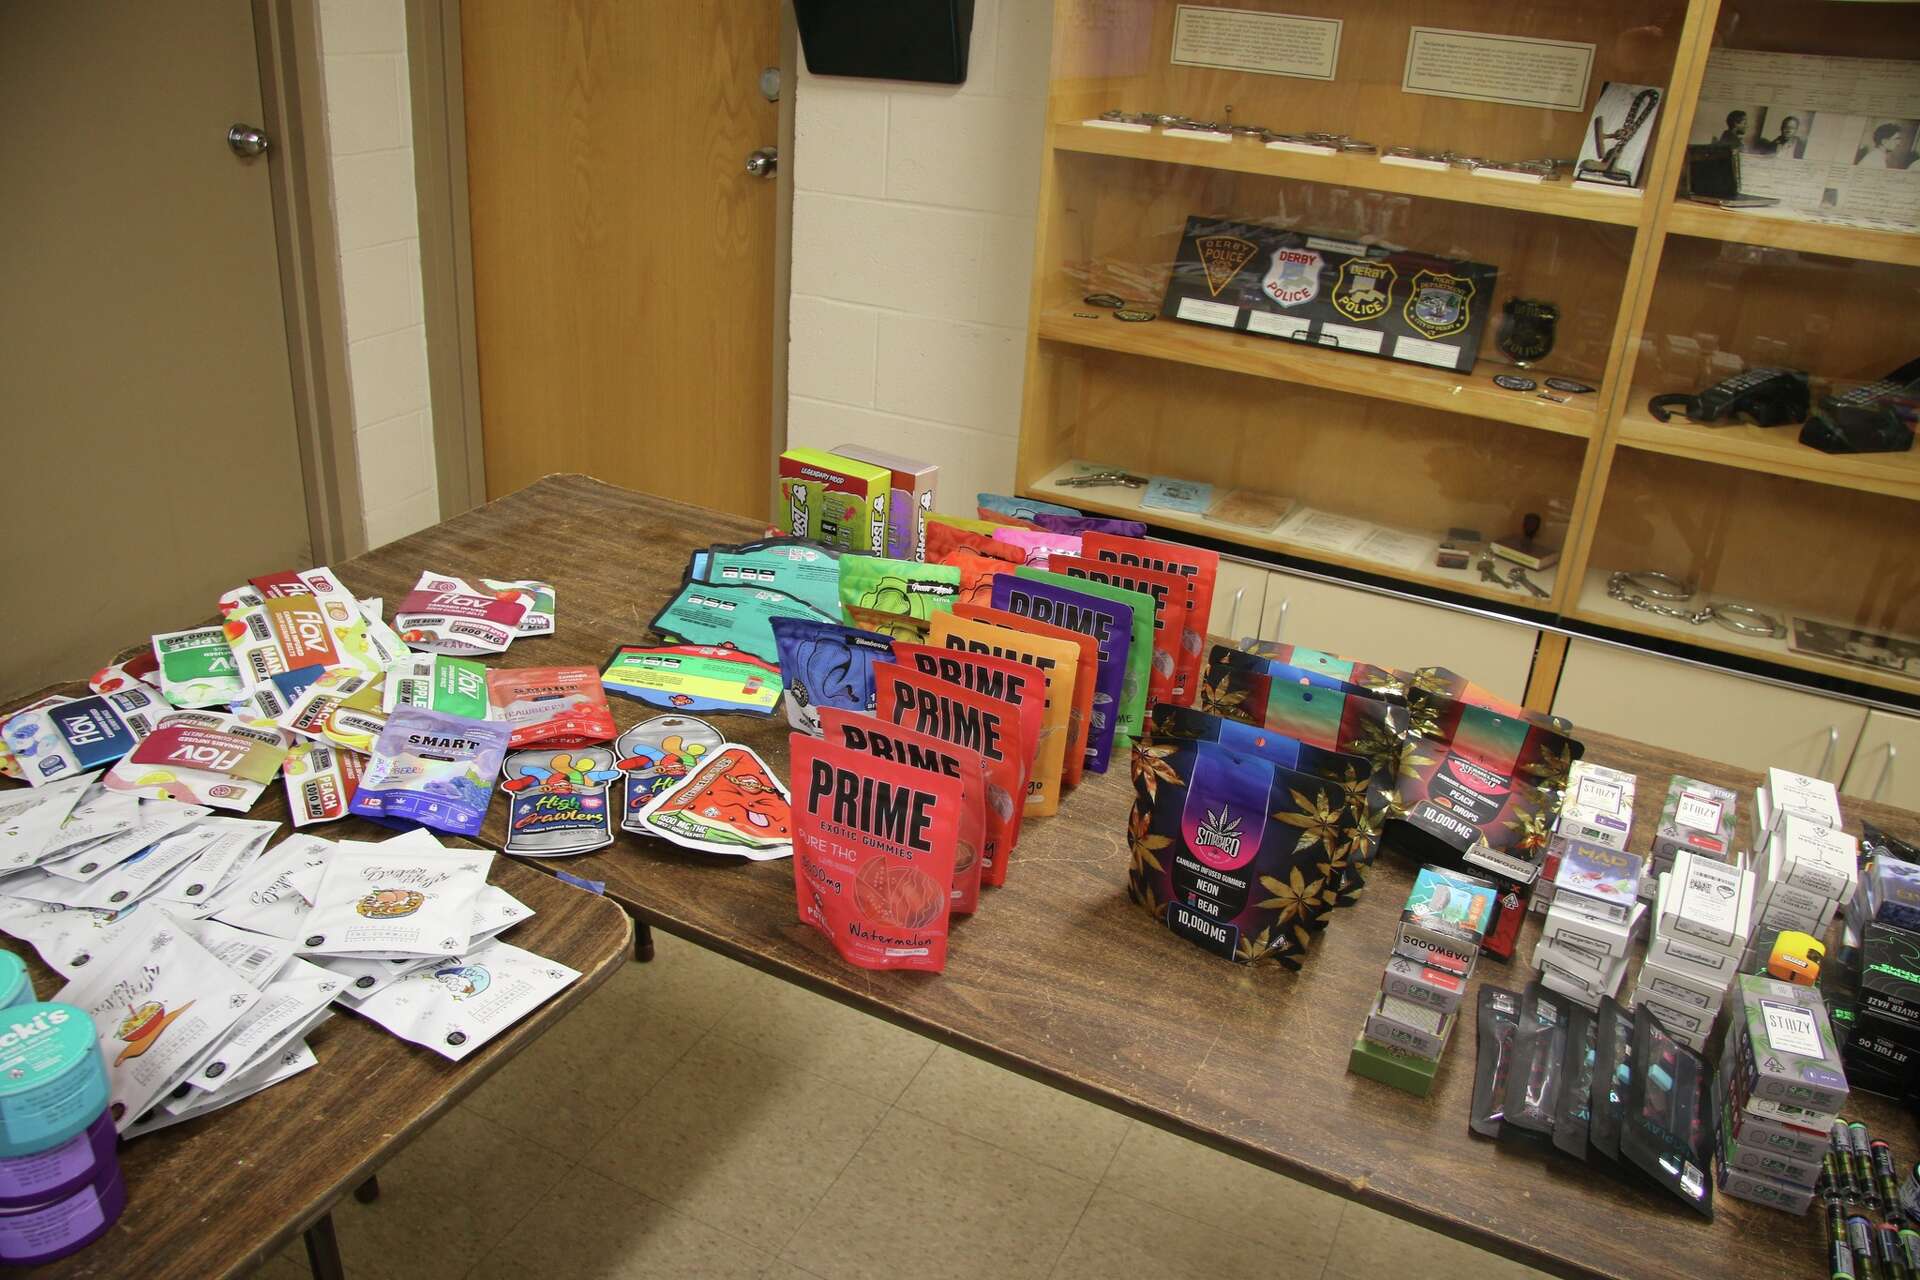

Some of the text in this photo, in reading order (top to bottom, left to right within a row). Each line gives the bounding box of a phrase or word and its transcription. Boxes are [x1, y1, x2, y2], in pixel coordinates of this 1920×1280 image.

[1206, 241, 1250, 252] DERBY
[1206, 248, 1244, 262] POLICE
[1280, 251, 1317, 266] DERBY
[1350, 265, 1388, 280] DERBY
[1267, 282, 1311, 301] POLICE
[1339, 296, 1383, 314] POLICE
[871, 512, 886, 558] HOST
[432, 593, 494, 608] flav
[293, 611, 329, 653] flav
[455, 625, 500, 643] 1000 MG
[855, 637, 889, 650] Blueberry
[252, 653, 267, 676] 1000
[261, 647, 282, 675] MAN
[299, 714, 311, 728] MG
[315, 697, 342, 726] PEACH
[892, 679, 1003, 763] PRIME
[66, 715, 104, 746] flav
[178, 736, 250, 753] CANNABIS INFUSED
[408, 735, 480, 750] SMART
[168, 745, 245, 770] flav
[320, 776, 337, 809] PEACH
[1449, 789, 1475, 807] PEACH
[311, 803, 323, 817] MG
[536, 795, 581, 811] High
[807, 757, 937, 851] PRIME
[515, 809, 603, 829] Crawlers
[1452, 805, 1480, 823] DROPS
[658, 814, 708, 835] 1500 MG THC
[798, 828, 857, 862] PURE THC
[820, 821, 913, 861] EXOTIC GUMMIES
[1176, 856, 1246, 889] CANNABIS INFUSED GUMMIES
[1196, 879, 1219, 897] NEON
[1197, 898, 1219, 917] BEAR
[849, 922, 932, 946] Watermelon
[1403, 936, 1471, 964] DABWOODS
[1867, 997, 1920, 1019] SILVER HAZE
[0, 1009, 70, 1047] cki's
[1859, 1038, 1908, 1063] JET FUEL OG
